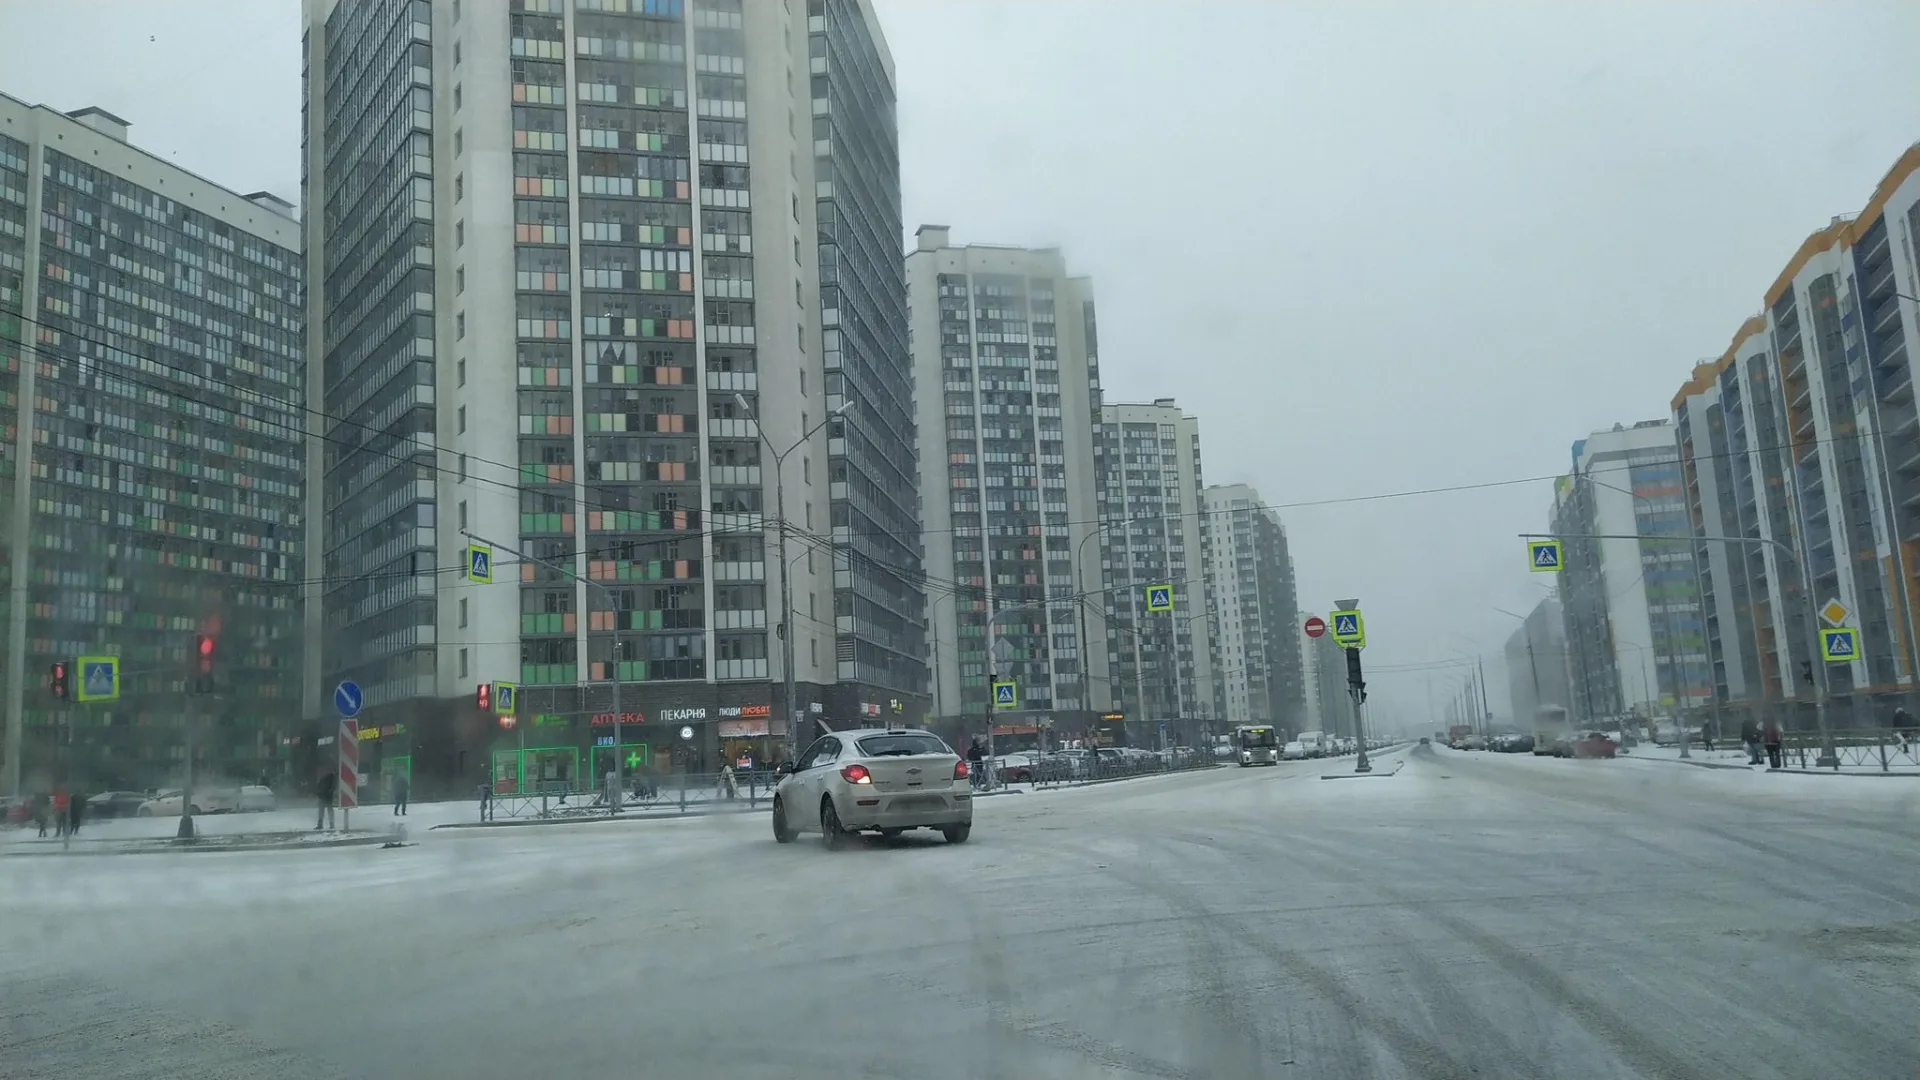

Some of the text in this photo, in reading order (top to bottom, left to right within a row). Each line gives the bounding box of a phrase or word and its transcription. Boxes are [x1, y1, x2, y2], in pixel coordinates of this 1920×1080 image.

[660, 708, 706, 720] ПЕКАРНЯ
[719, 705, 770, 717] ЛЮДИ ЛЮБЯТ
[590, 712, 645, 724] АПТЕКА
